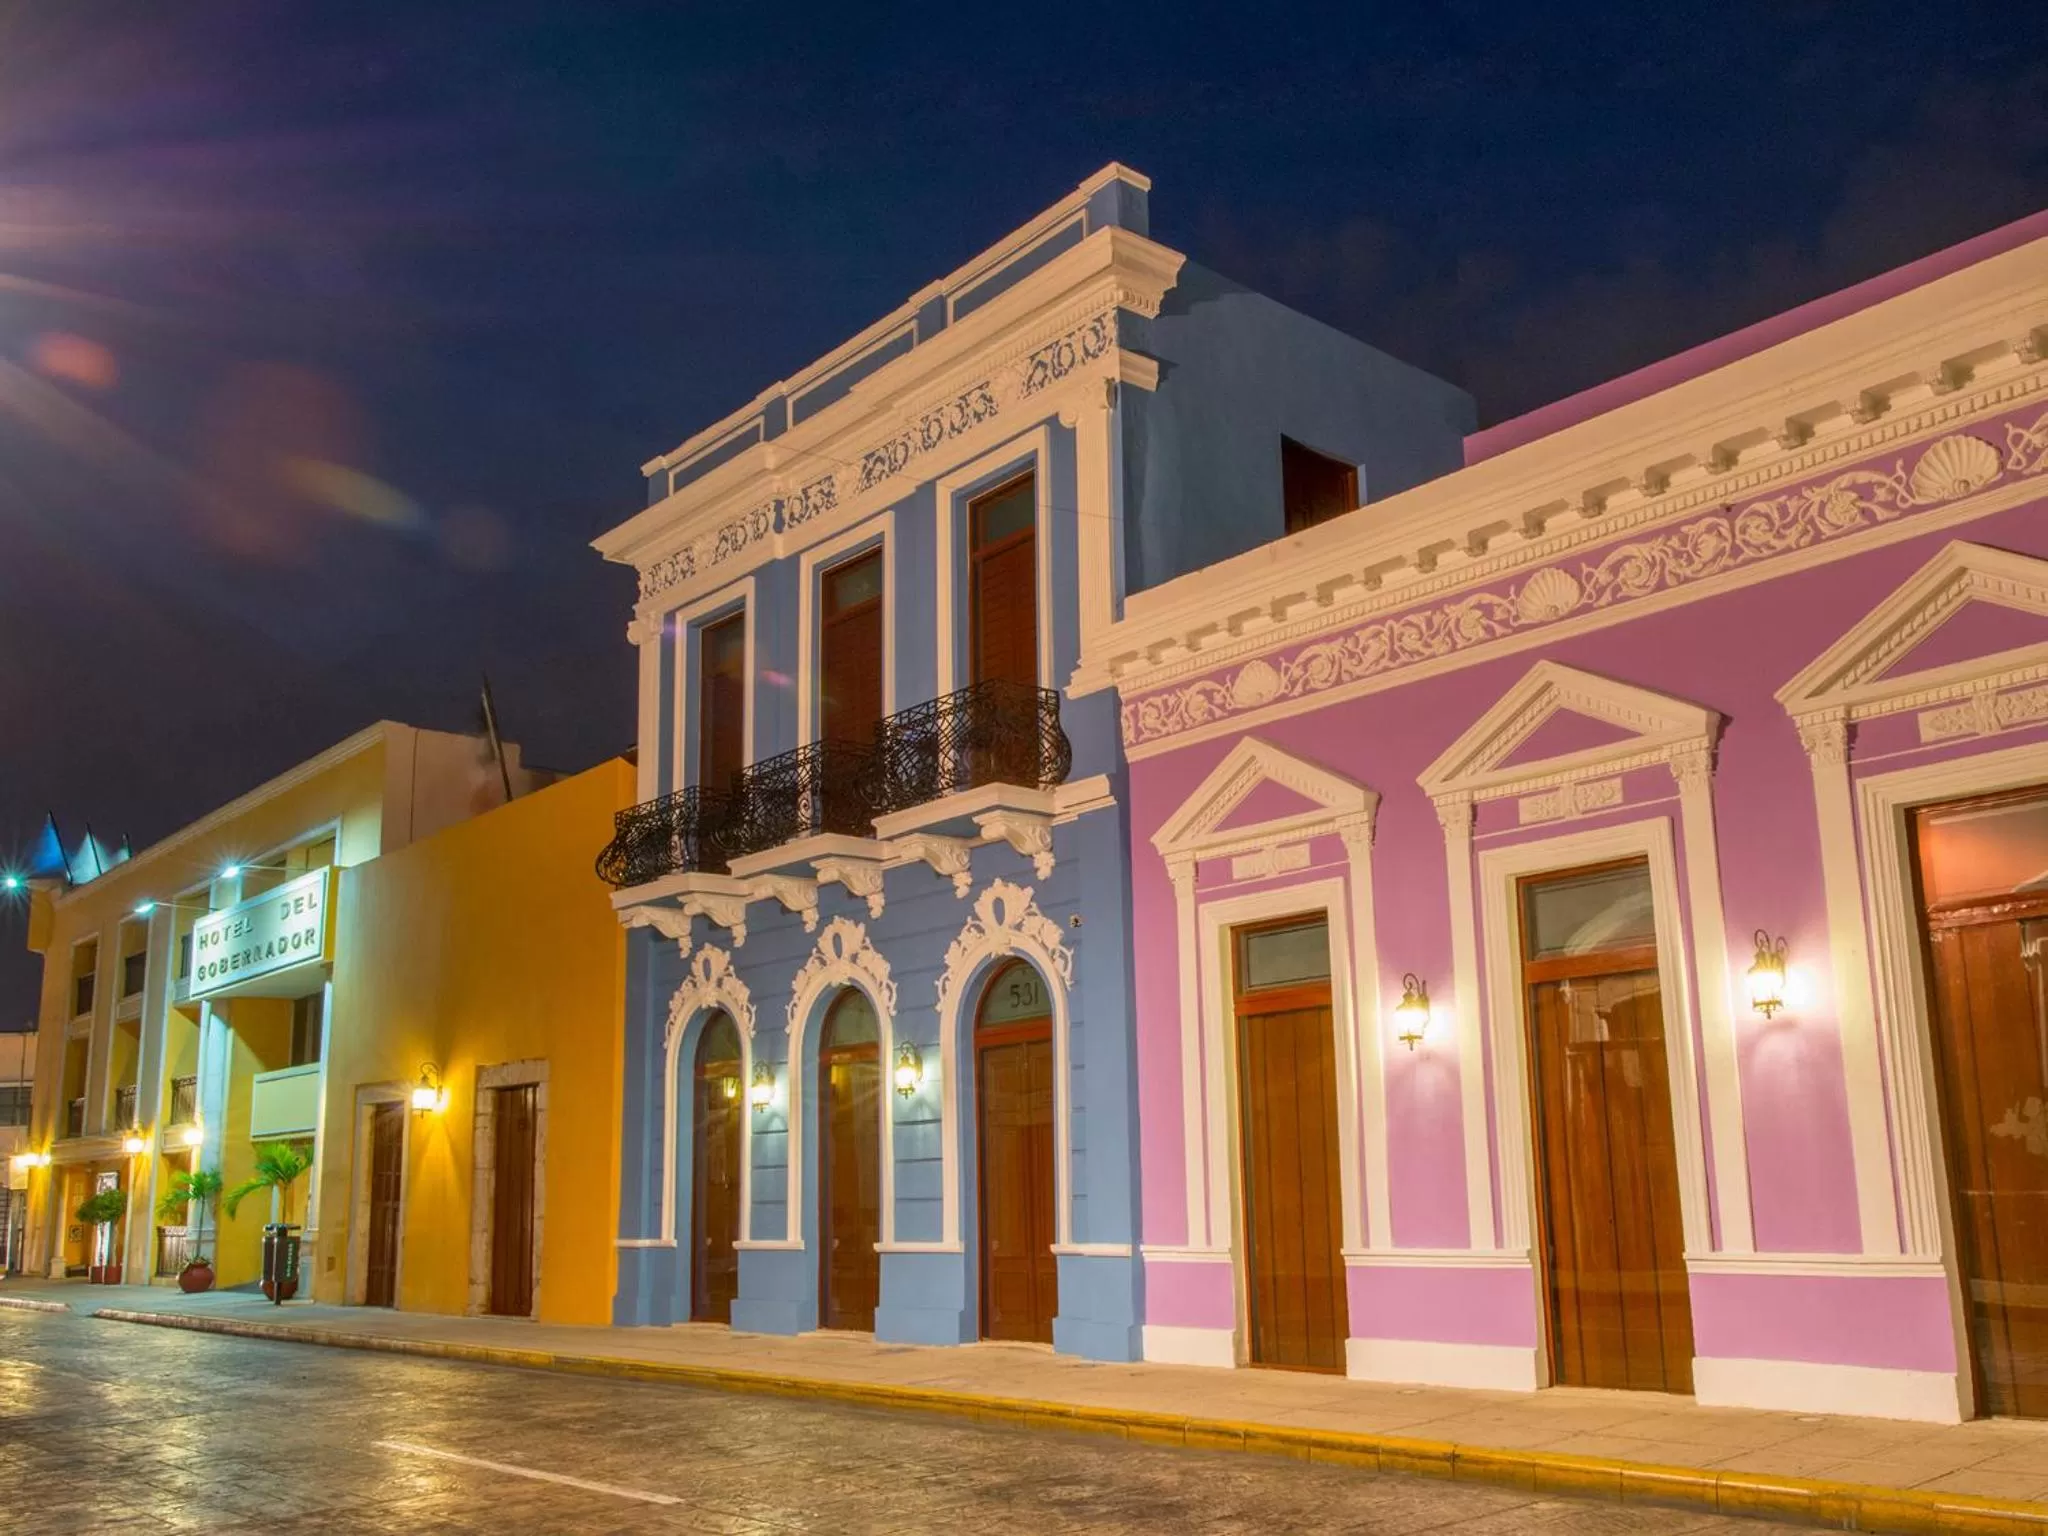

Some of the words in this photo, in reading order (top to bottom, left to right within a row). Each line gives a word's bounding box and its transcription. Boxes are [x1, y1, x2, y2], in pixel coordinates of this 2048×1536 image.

[199, 917, 253, 950] HOTEL
[280, 892, 317, 921] DEL
[197, 927, 316, 981] GOBERNADOR
[1010, 982, 1038, 1008] 531
